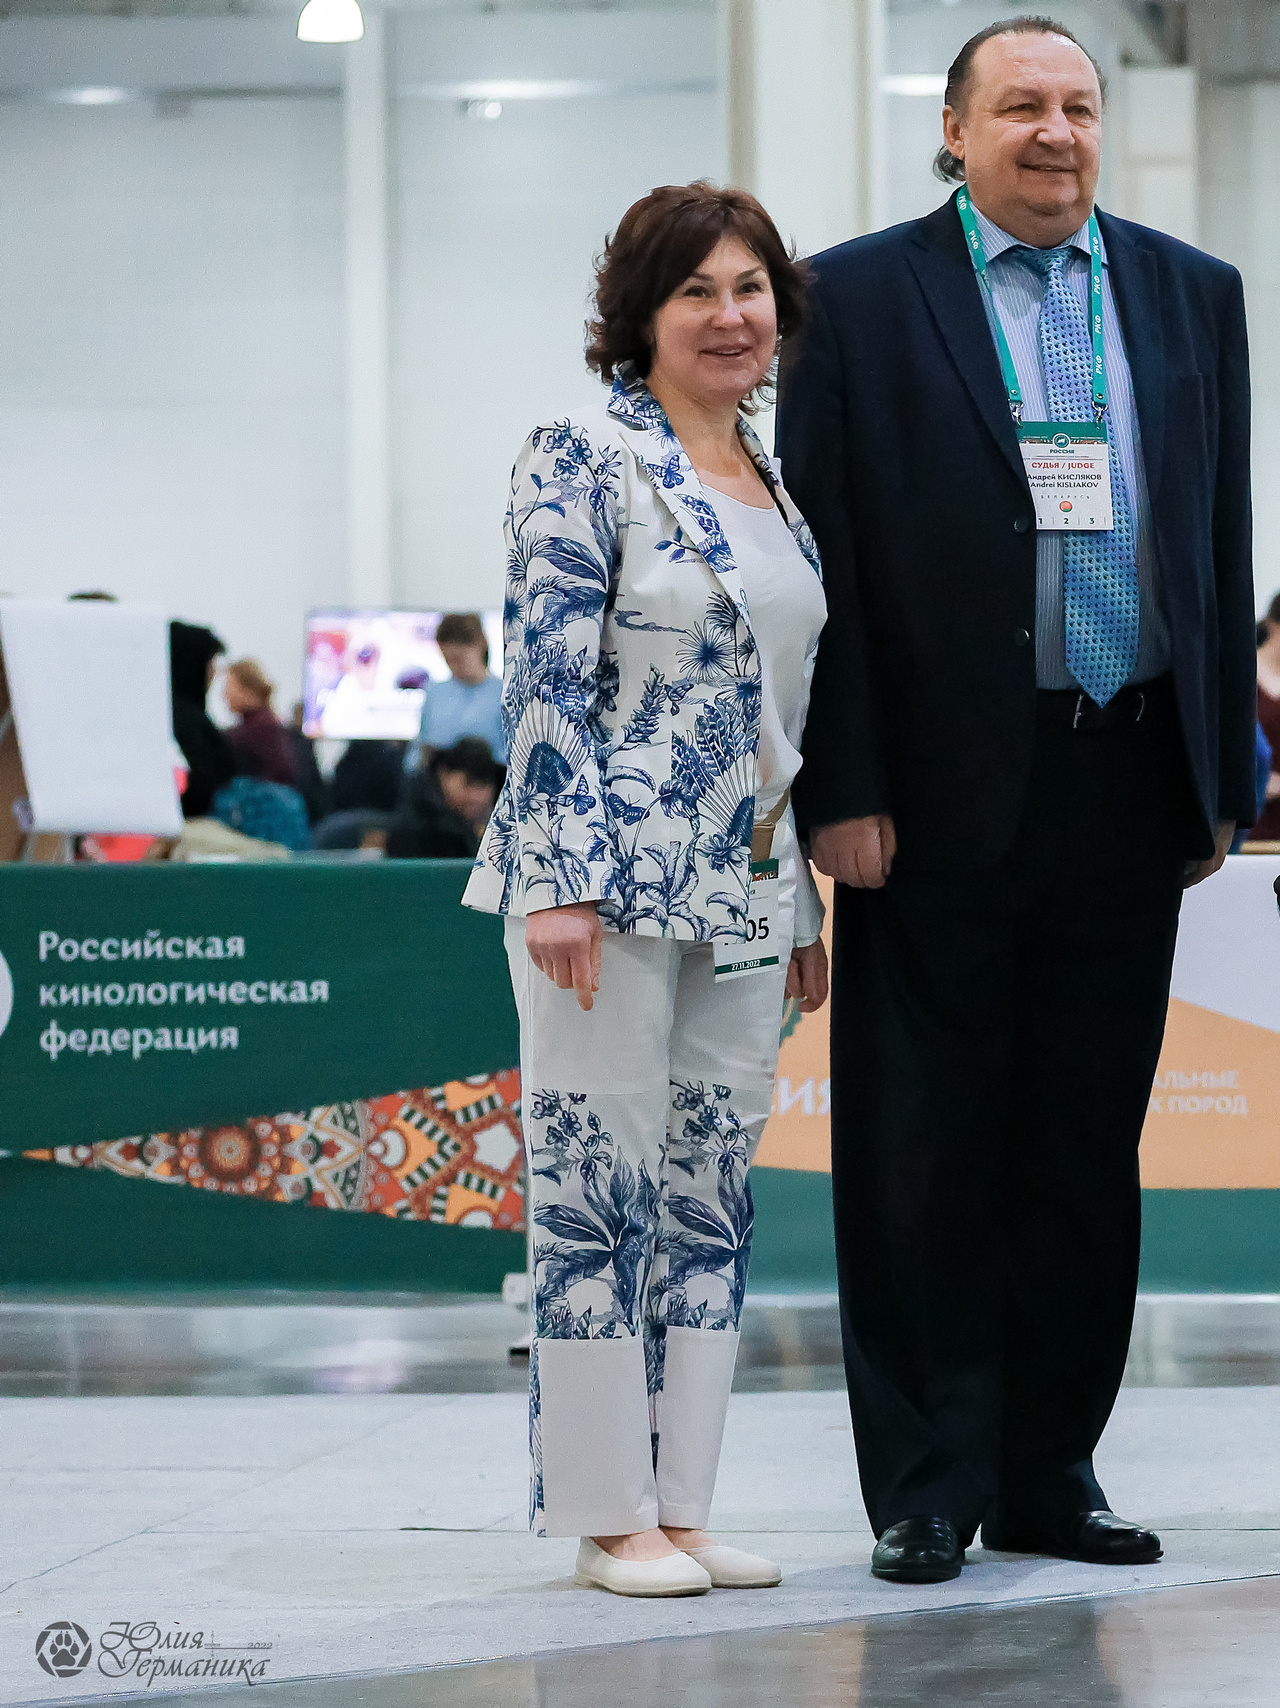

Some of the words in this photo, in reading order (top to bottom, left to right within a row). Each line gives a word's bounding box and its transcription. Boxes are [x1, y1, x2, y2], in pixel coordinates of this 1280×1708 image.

[1092, 237, 1100, 255] РКФ
[1093, 275, 1101, 295] РКФ
[1094, 314, 1102, 334] РКФ
[1095, 355, 1103, 375] РКФ
[1068, 462, 1095, 470] JUDGE
[38, 929, 246, 962] Российская
[731, 960, 761, 971] 27.11.2022
[39, 979, 330, 1007] кинологическая
[39, 1019, 239, 1060] федерация
[1168, 1095, 1248, 1116] ПОРОД
